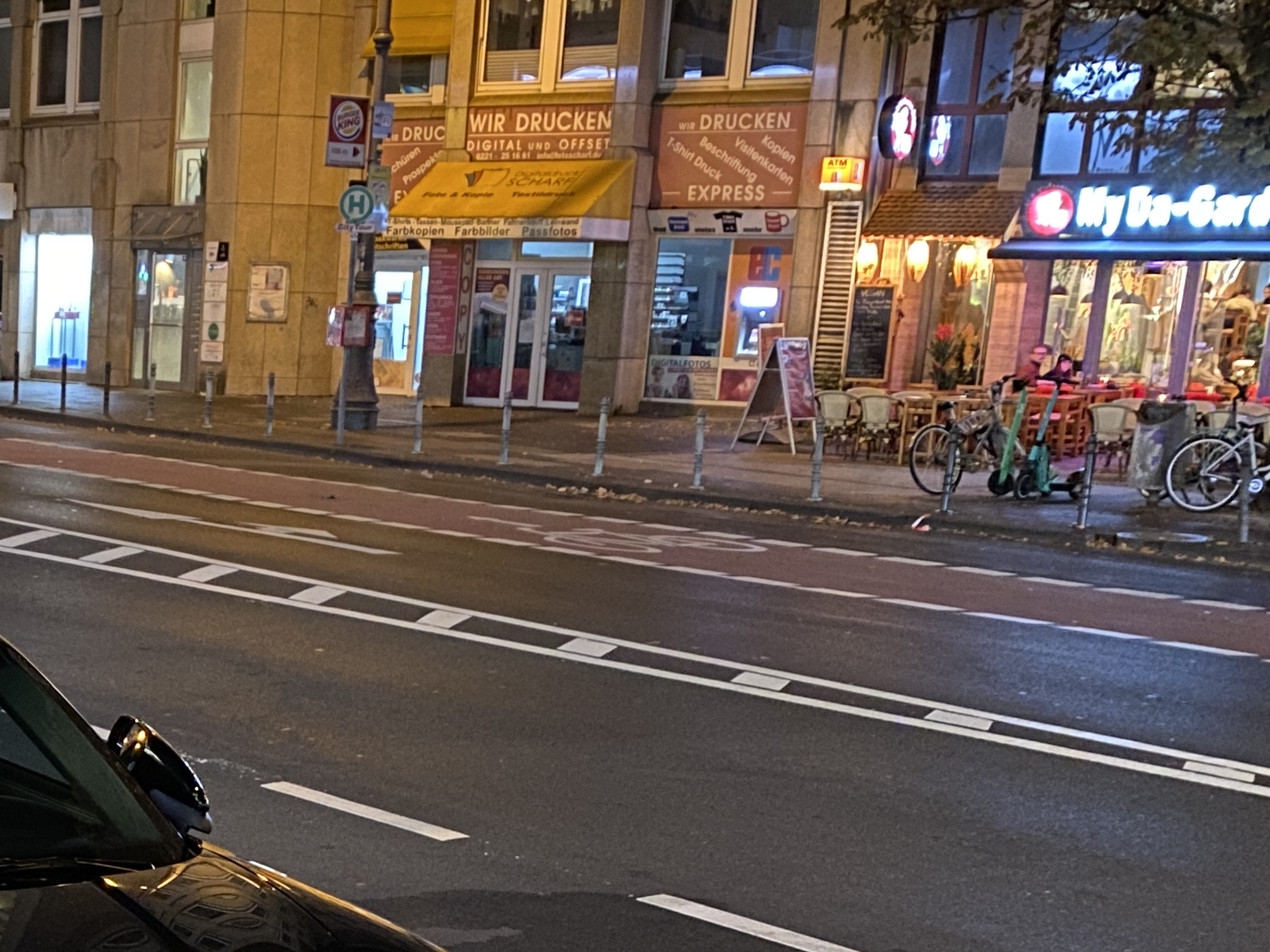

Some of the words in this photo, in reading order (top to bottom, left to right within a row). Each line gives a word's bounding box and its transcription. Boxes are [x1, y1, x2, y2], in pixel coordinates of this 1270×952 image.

[338, 115, 360, 130] KING
[470, 113, 505, 132] WIR
[516, 111, 612, 132] DRUCKEN
[679, 122, 695, 130] WIR
[700, 112, 791, 130] DRUCKEN
[384, 134, 399, 142] IR
[467, 139, 522, 151] DIGITAL
[528, 142, 551, 151] UND
[558, 138, 610, 150] OFFSET
[760, 134, 796, 165] Kopien
[666, 137, 695, 162] T-Shirt
[693, 156, 723, 182] Druck
[699, 136, 758, 183] Beschriftung
[734, 135, 794, 186] Visitenkarten
[828, 159, 847, 167] ATM
[506, 177, 575, 187] SCHARF
[687, 185, 765, 201] EXPRESS
[386, 226, 444, 236] Farbkopien
[455, 226, 510, 236] Farbbilder
[522, 227, 577, 236] Passfotos
[458, 248, 471, 350] COPY
[651, 359, 711, 368] DIGITALFOTOS
